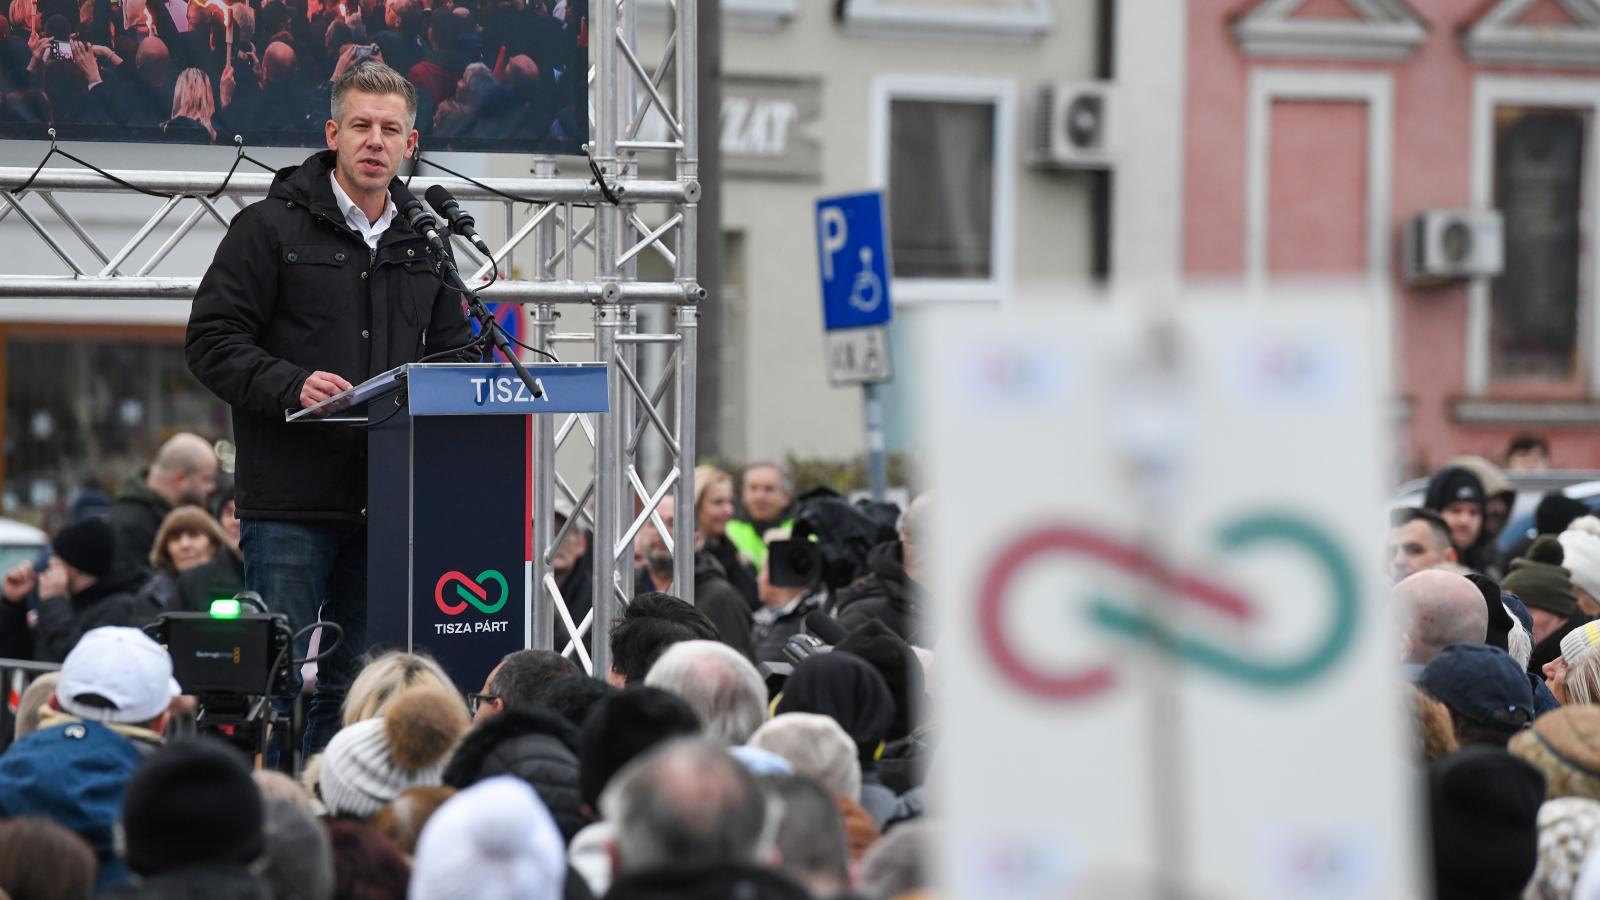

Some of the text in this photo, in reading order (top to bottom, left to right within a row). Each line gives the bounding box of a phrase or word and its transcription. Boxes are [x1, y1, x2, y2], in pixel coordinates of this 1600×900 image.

[719, 99, 798, 154] ZAT
[821, 206, 848, 281] P
[470, 377, 549, 403] TISZA
[434, 619, 509, 635] TISZA PÁRT
